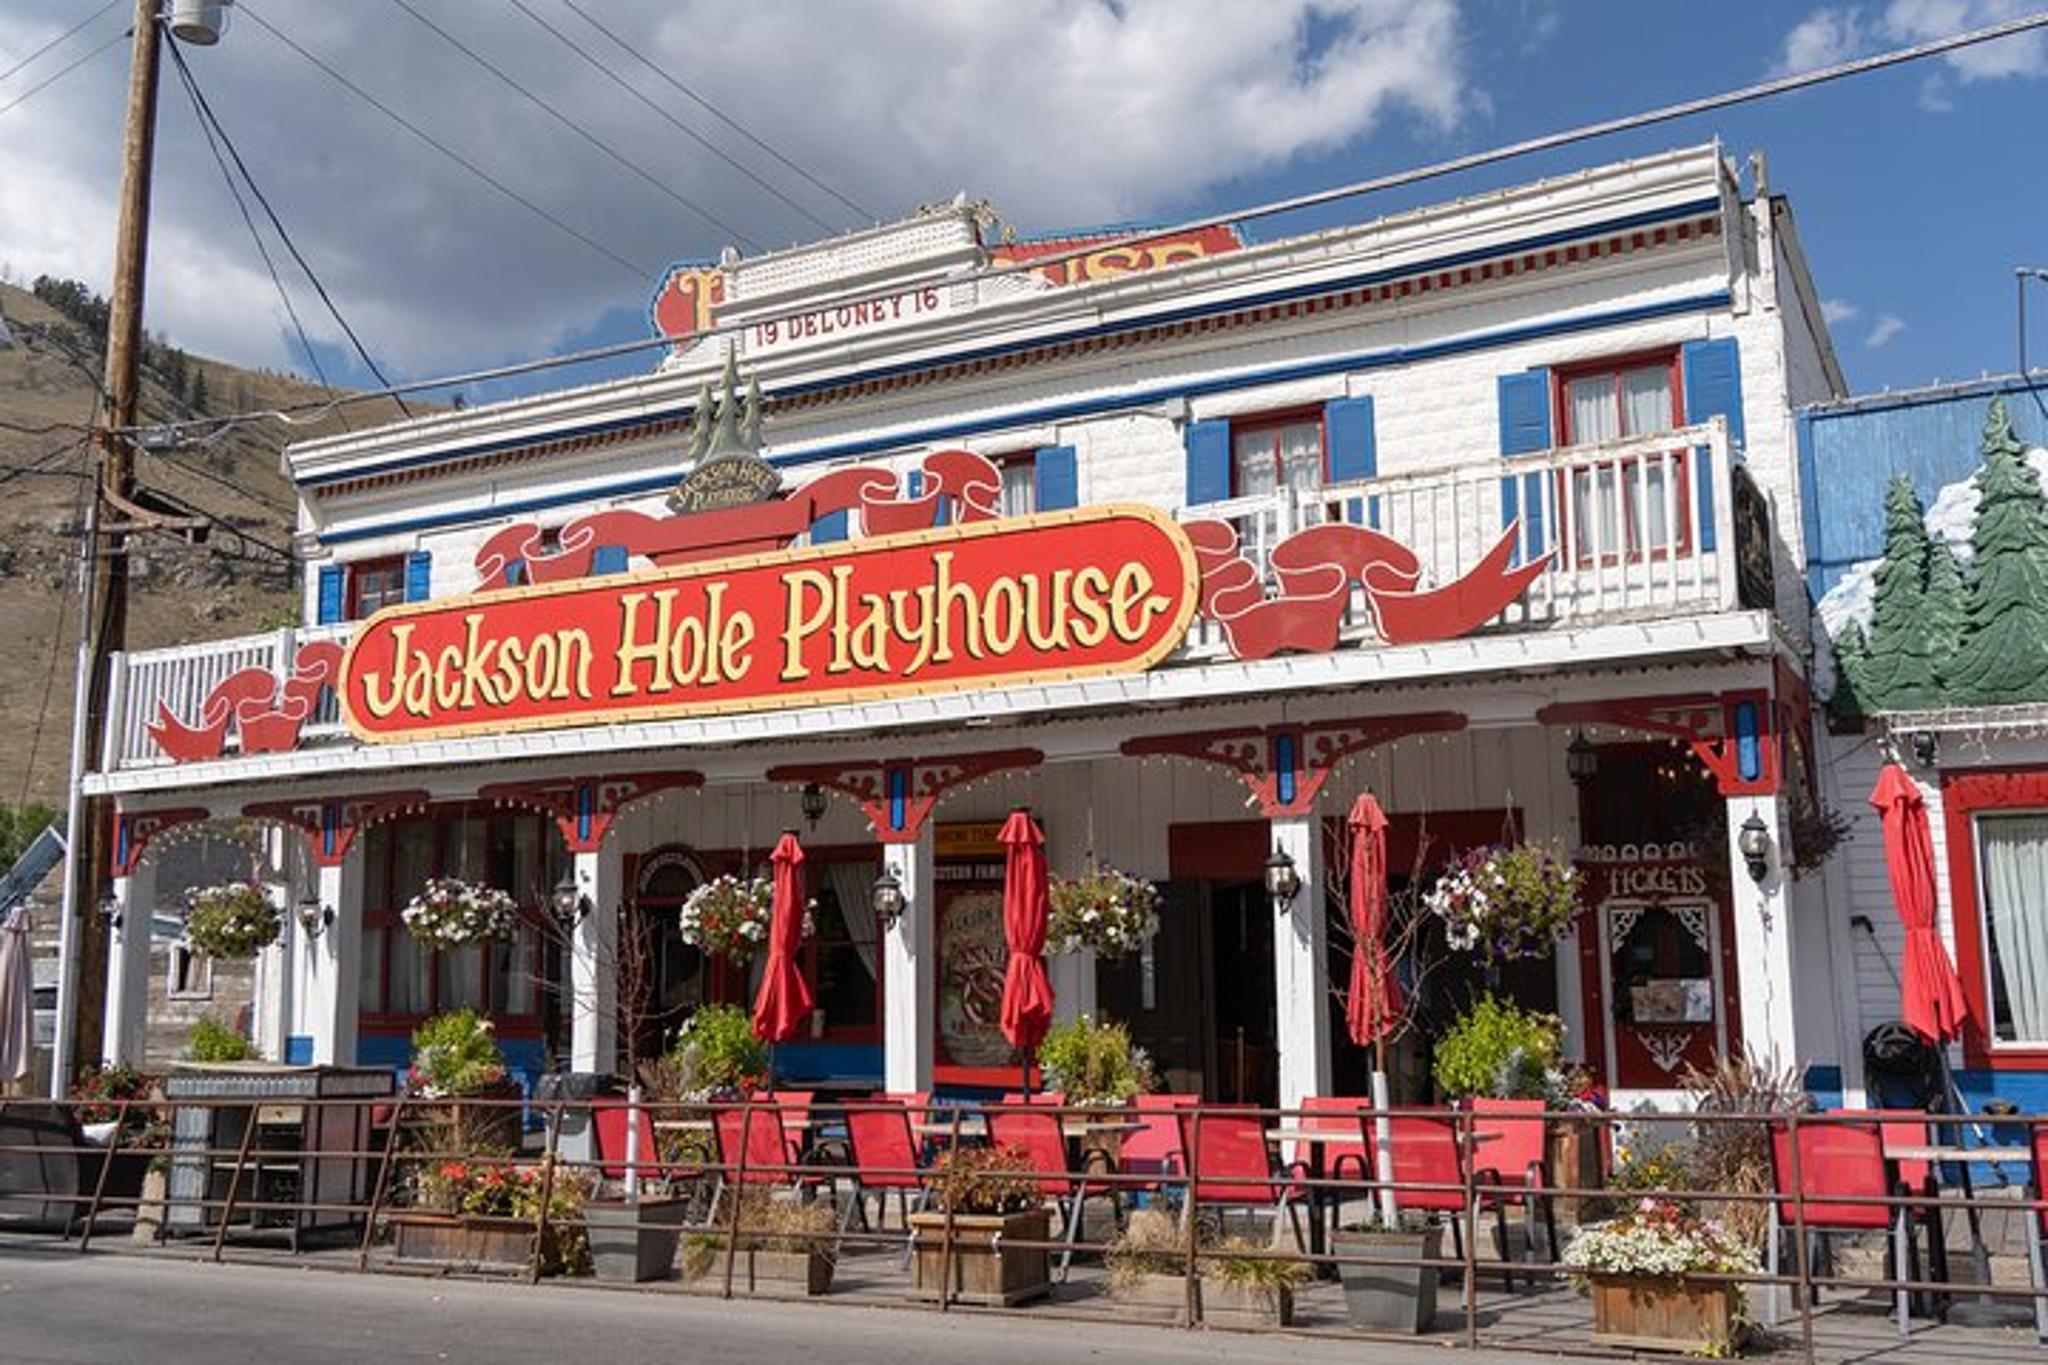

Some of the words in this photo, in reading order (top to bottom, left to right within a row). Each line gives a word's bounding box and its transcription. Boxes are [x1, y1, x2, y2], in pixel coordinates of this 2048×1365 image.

[756, 322, 778, 347] 19
[787, 295, 904, 339] DELONEY
[914, 286, 938, 313] 16
[362, 614, 594, 718] Jackson
[612, 582, 756, 694] Hole
[781, 551, 1173, 678] Playhouse
[1603, 866, 1708, 897] TICKETS
